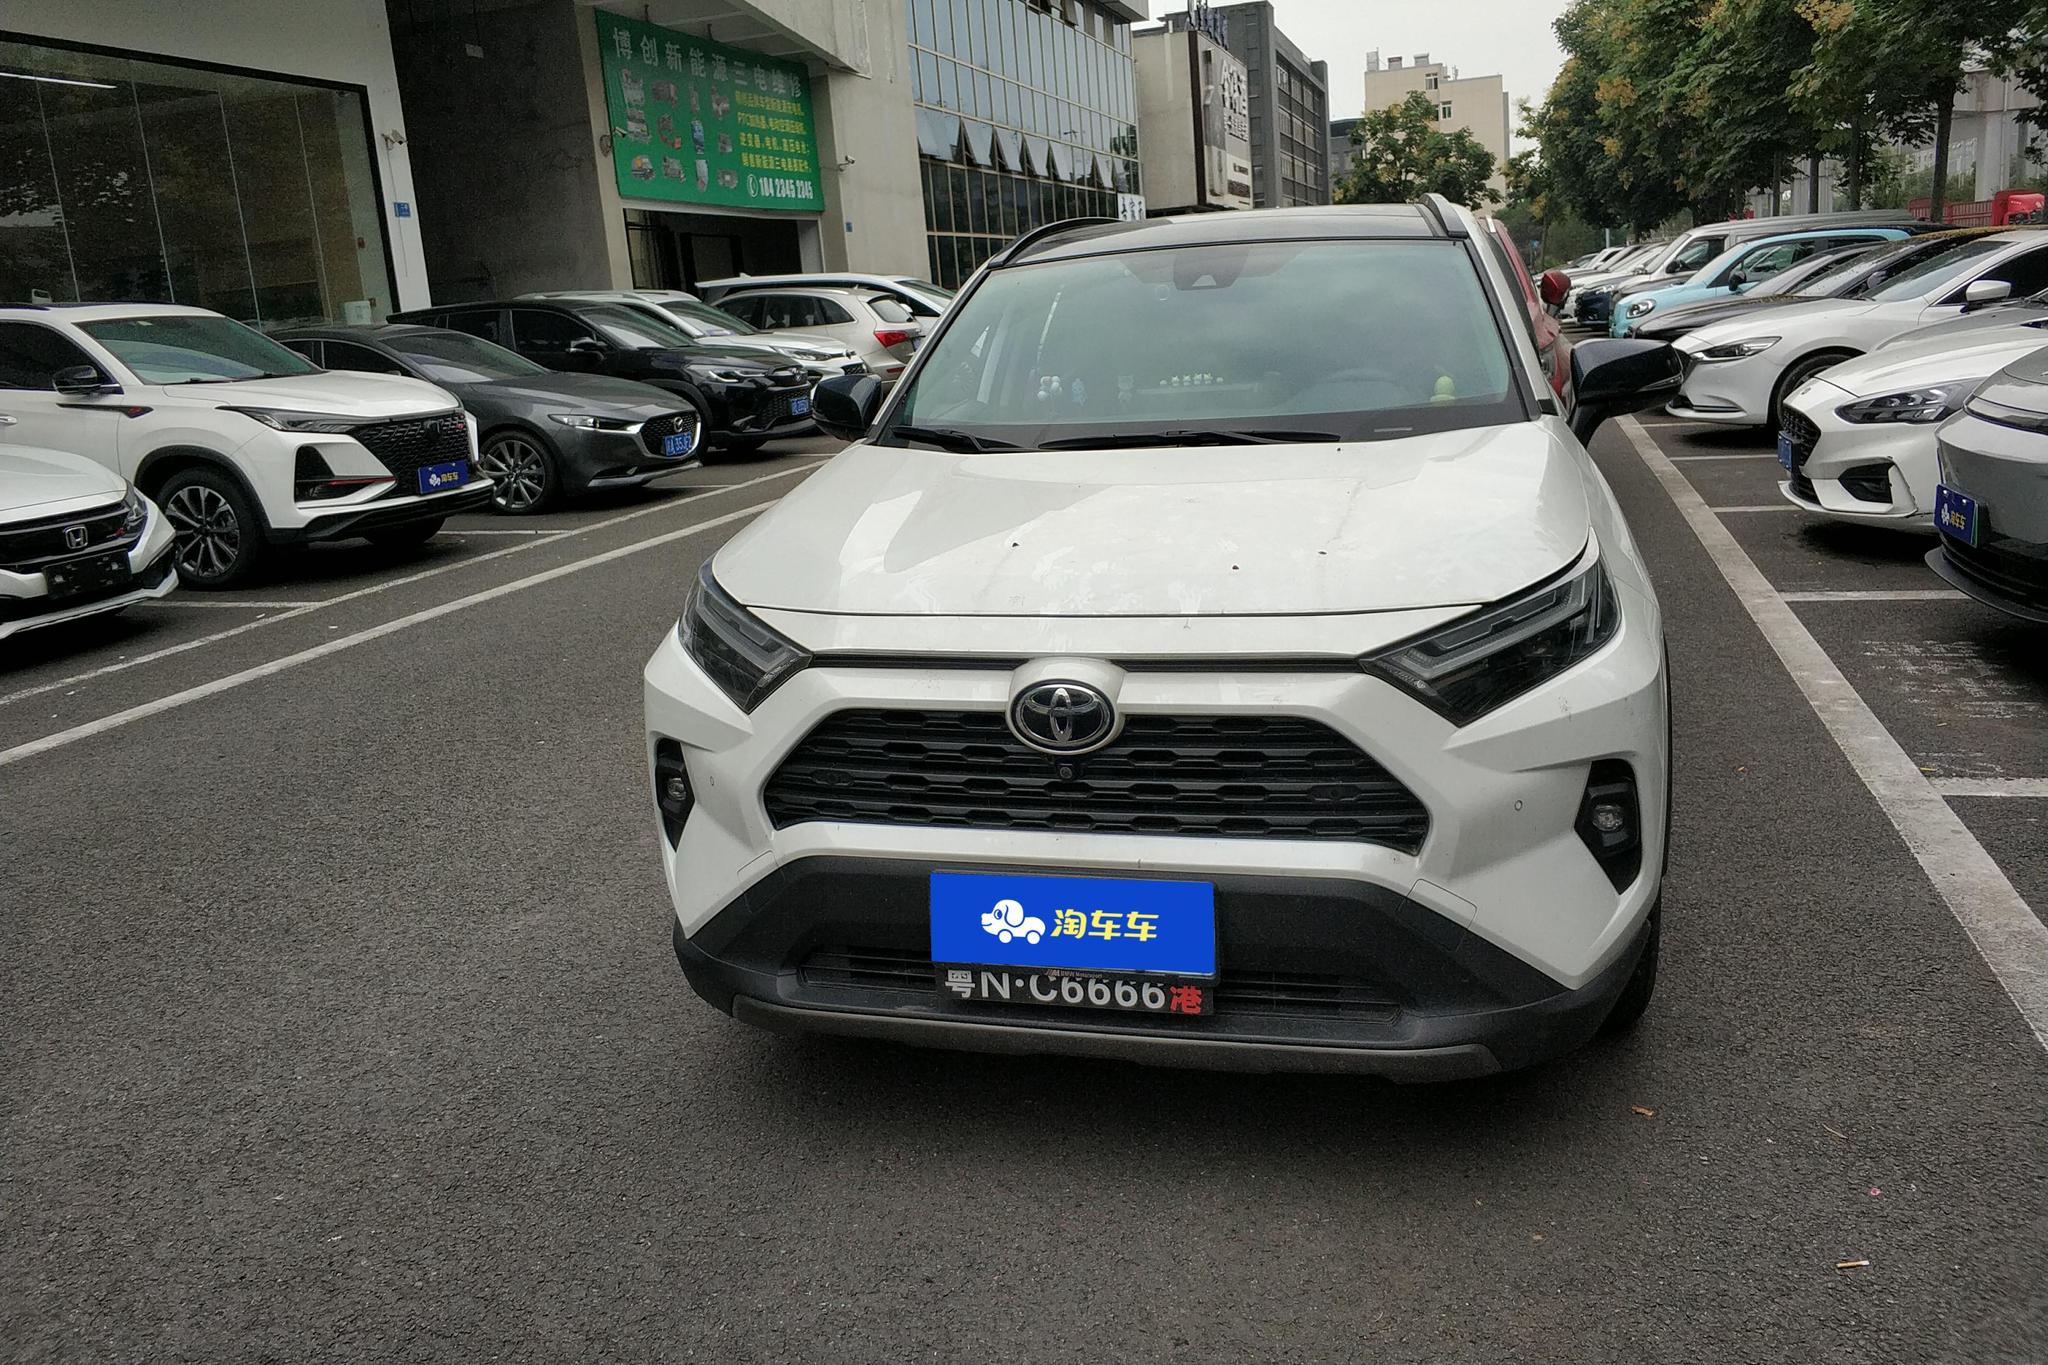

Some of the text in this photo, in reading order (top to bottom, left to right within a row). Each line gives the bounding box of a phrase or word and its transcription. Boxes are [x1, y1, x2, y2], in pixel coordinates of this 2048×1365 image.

[612, 27, 802, 98] 博创新能源三电维修
